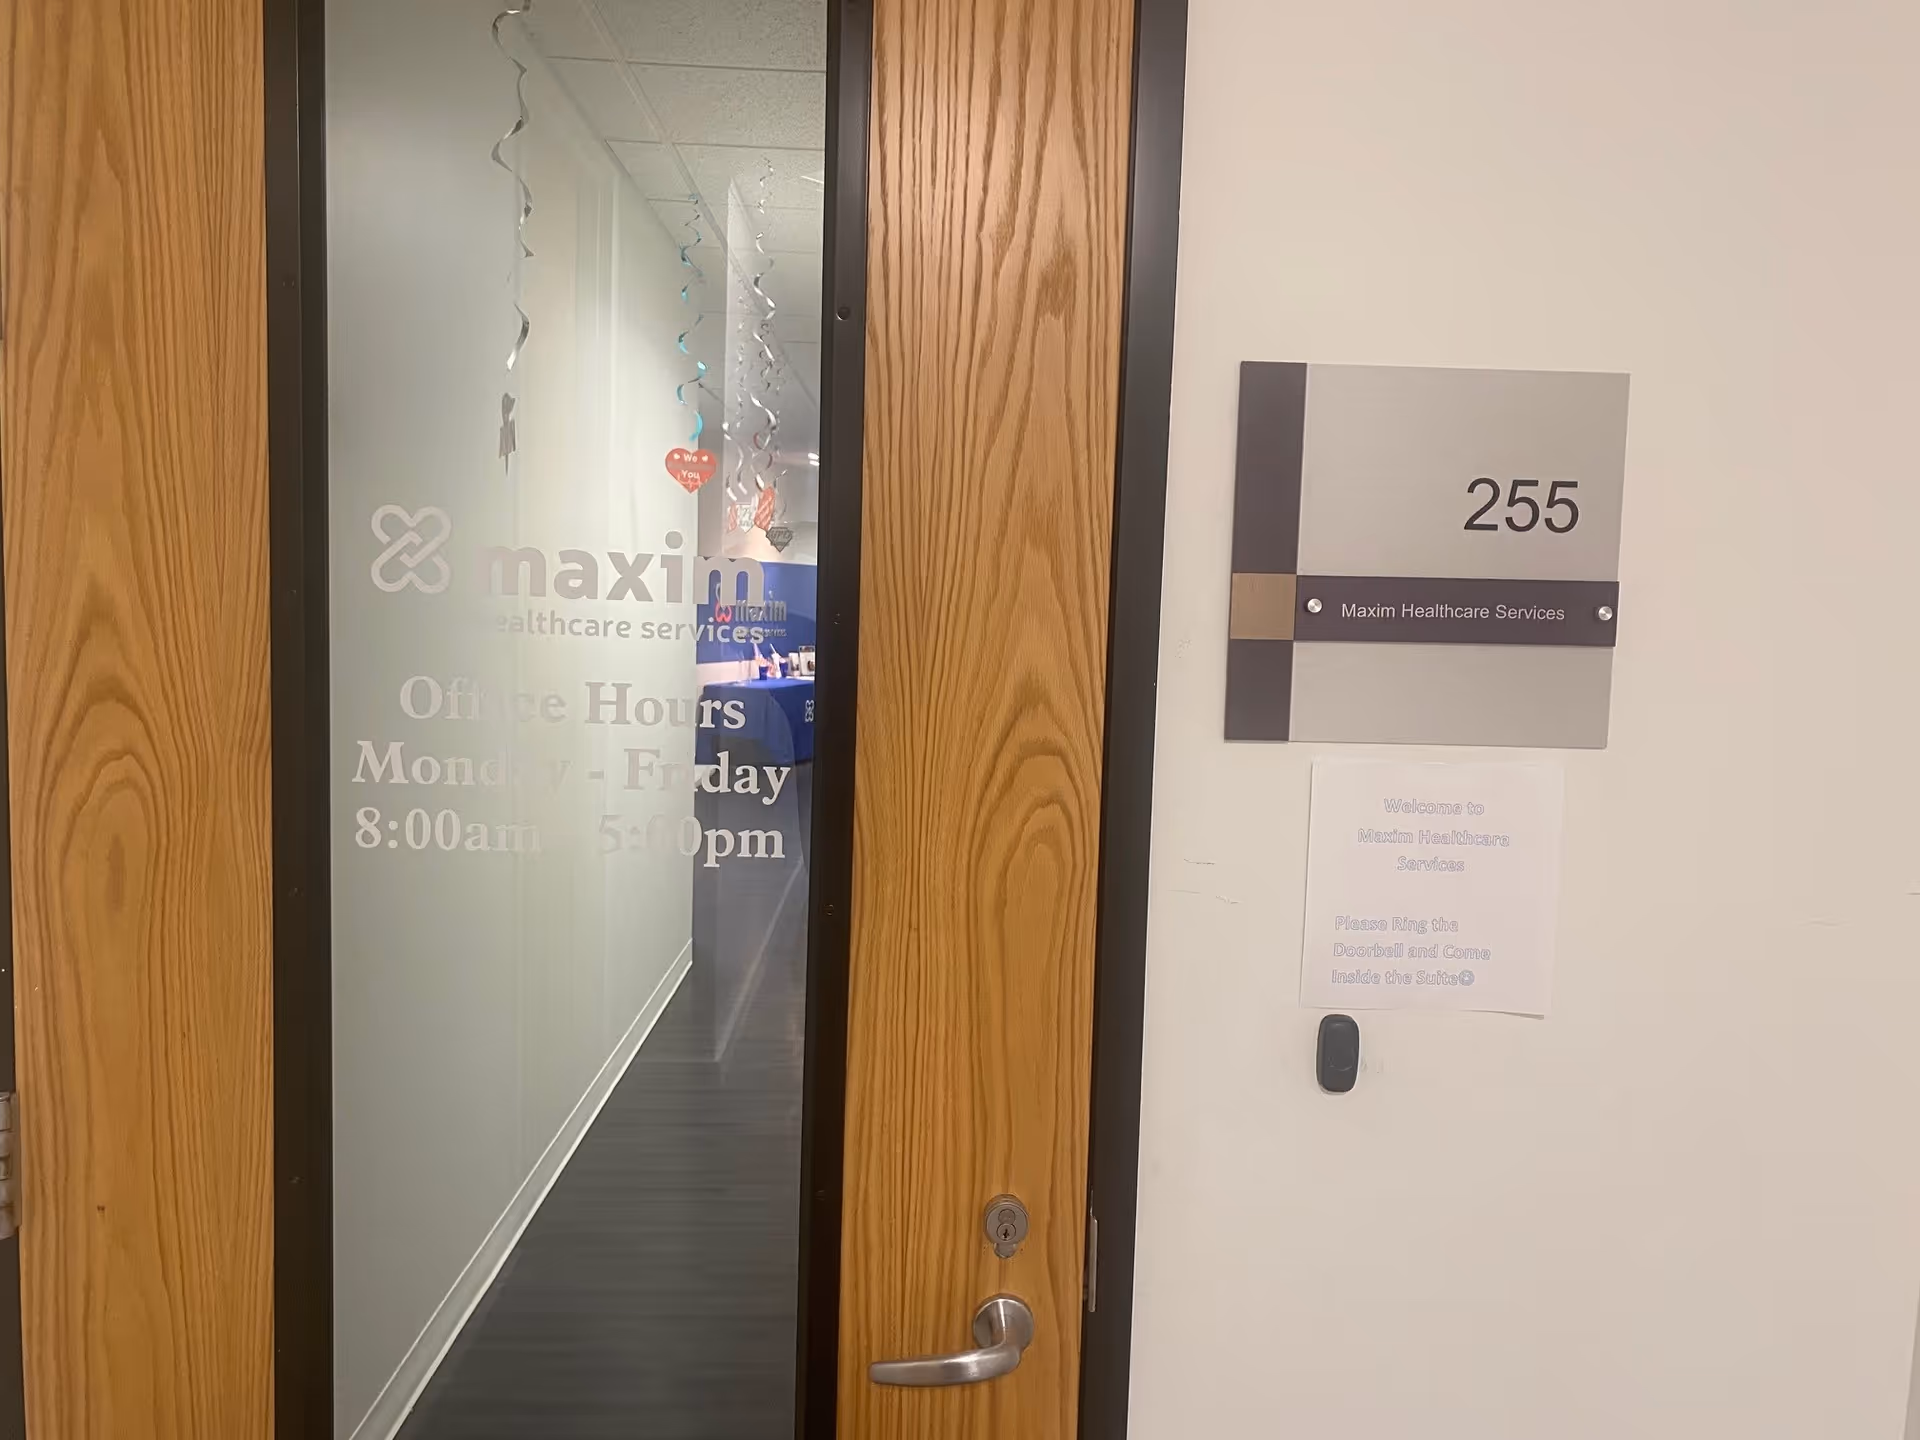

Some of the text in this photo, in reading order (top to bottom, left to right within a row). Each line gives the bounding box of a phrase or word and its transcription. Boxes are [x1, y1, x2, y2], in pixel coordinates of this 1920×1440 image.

[681, 470, 700, 479] You
[1463, 477, 1580, 533] 255
[478, 530, 765, 606] maxim
[1341, 603, 1566, 621] Maxim Healthcare Services
[496, 609, 632, 638] ealthcare
[640, 616, 765, 644] services
[400, 674, 747, 729] Offce Hours
[352, 740, 574, 801] Mondy
[624, 747, 792, 805] Frday
[1383, 798, 1485, 816] Welcome to
[354, 806, 543, 852] 8:00am
[1357, 828, 1510, 847] Maxim Healthcare
[1397, 855, 1465, 872] Services
[1334, 915, 1459, 934] Please Ring the
[1333, 943, 1492, 960] Doorbell and Come
[1331, 969, 1459, 986] Inside the Suite
